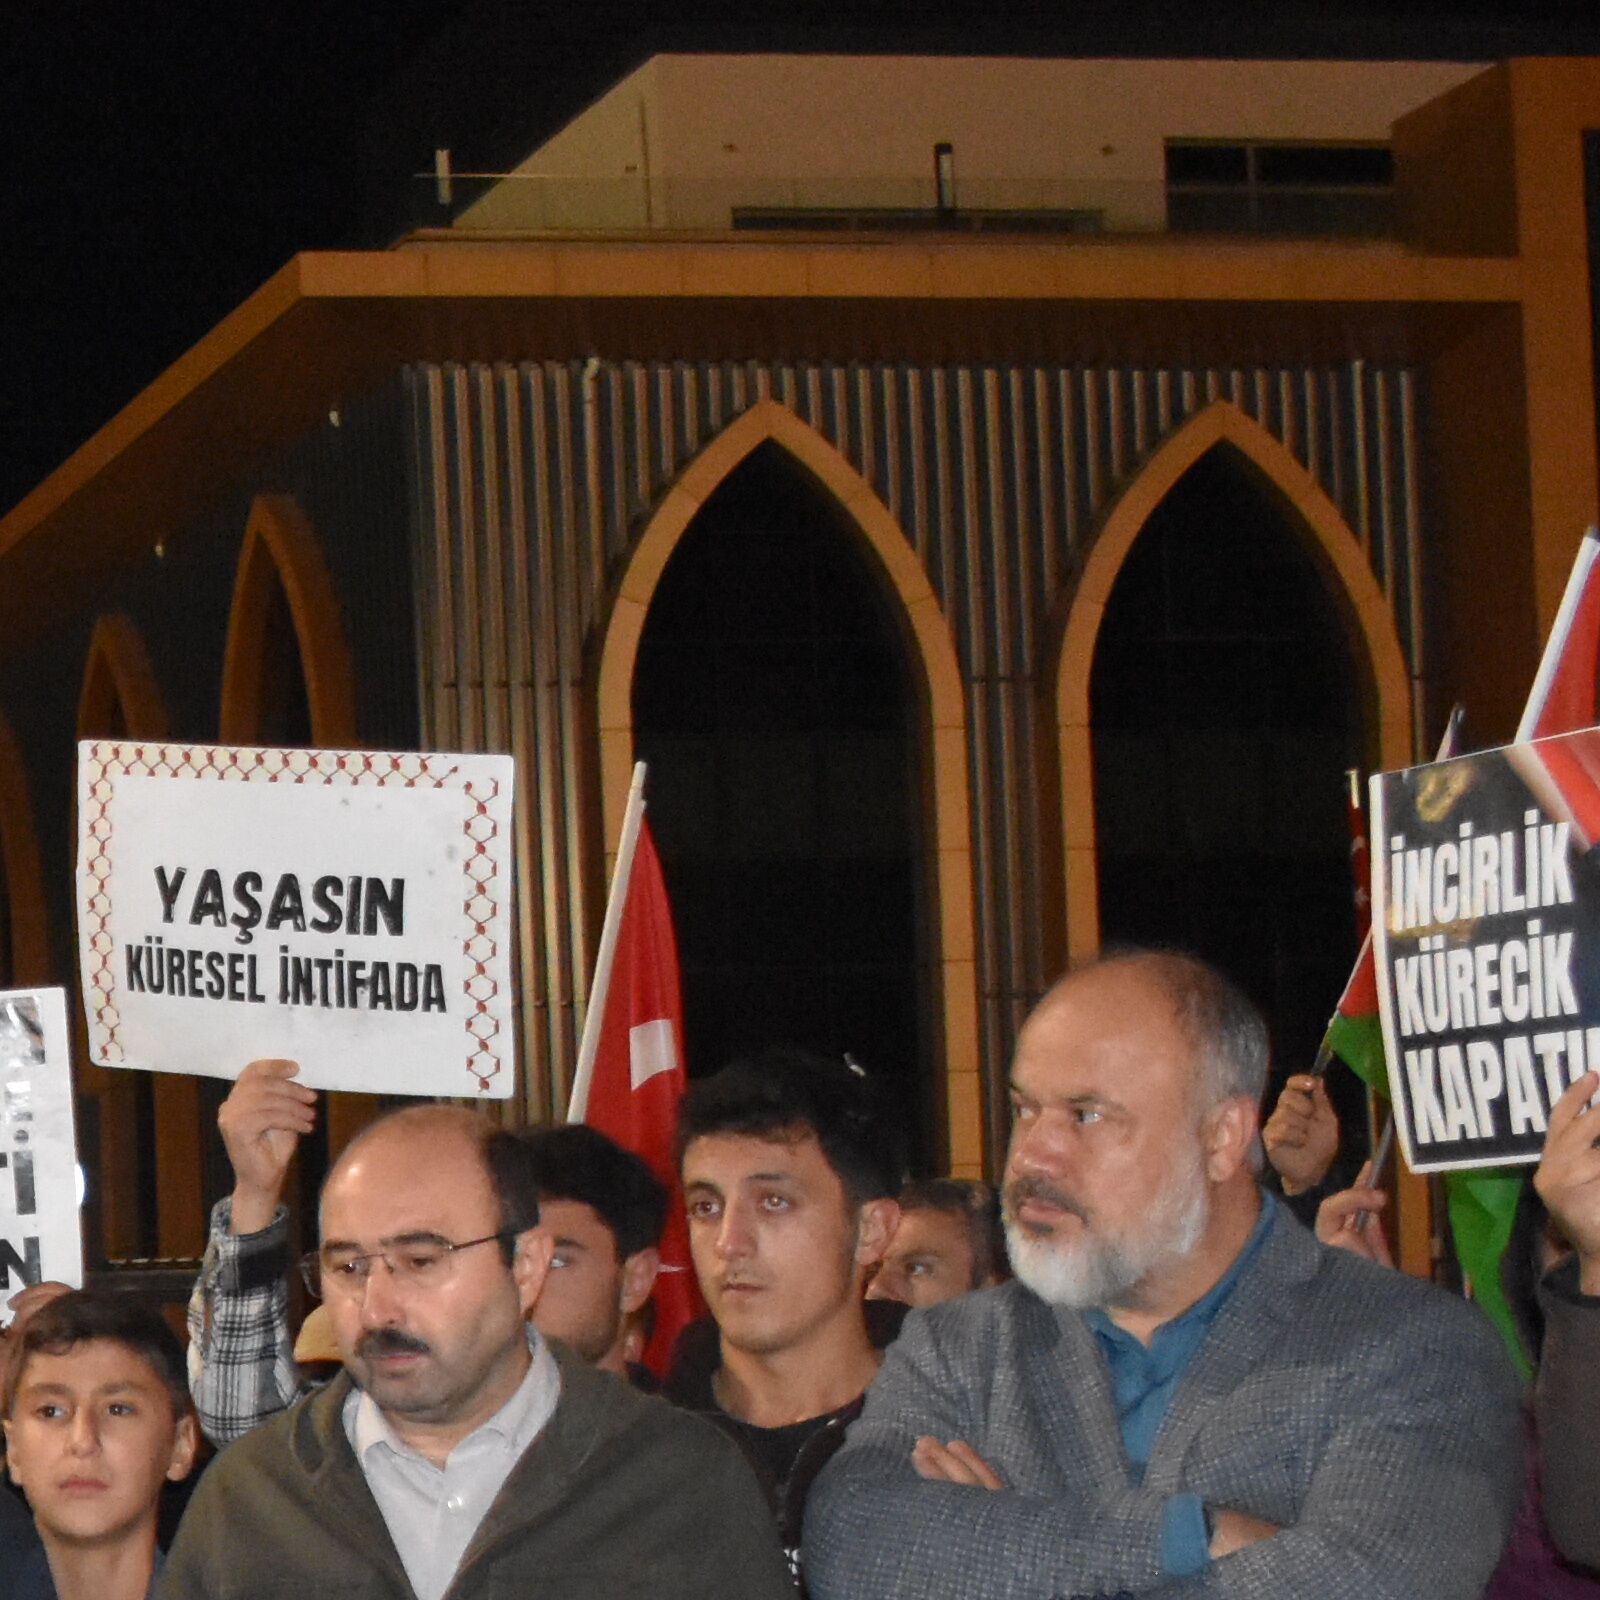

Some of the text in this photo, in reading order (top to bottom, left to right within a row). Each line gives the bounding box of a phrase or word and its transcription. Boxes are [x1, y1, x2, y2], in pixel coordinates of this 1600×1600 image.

[153, 865, 405, 945] YAŞASIN
[1391, 808, 1574, 932] İNCİRLİK
[125, 935, 447, 1013] KÜRESEL İNTİFADA
[1394, 919, 1580, 1037] KÜRECİK
